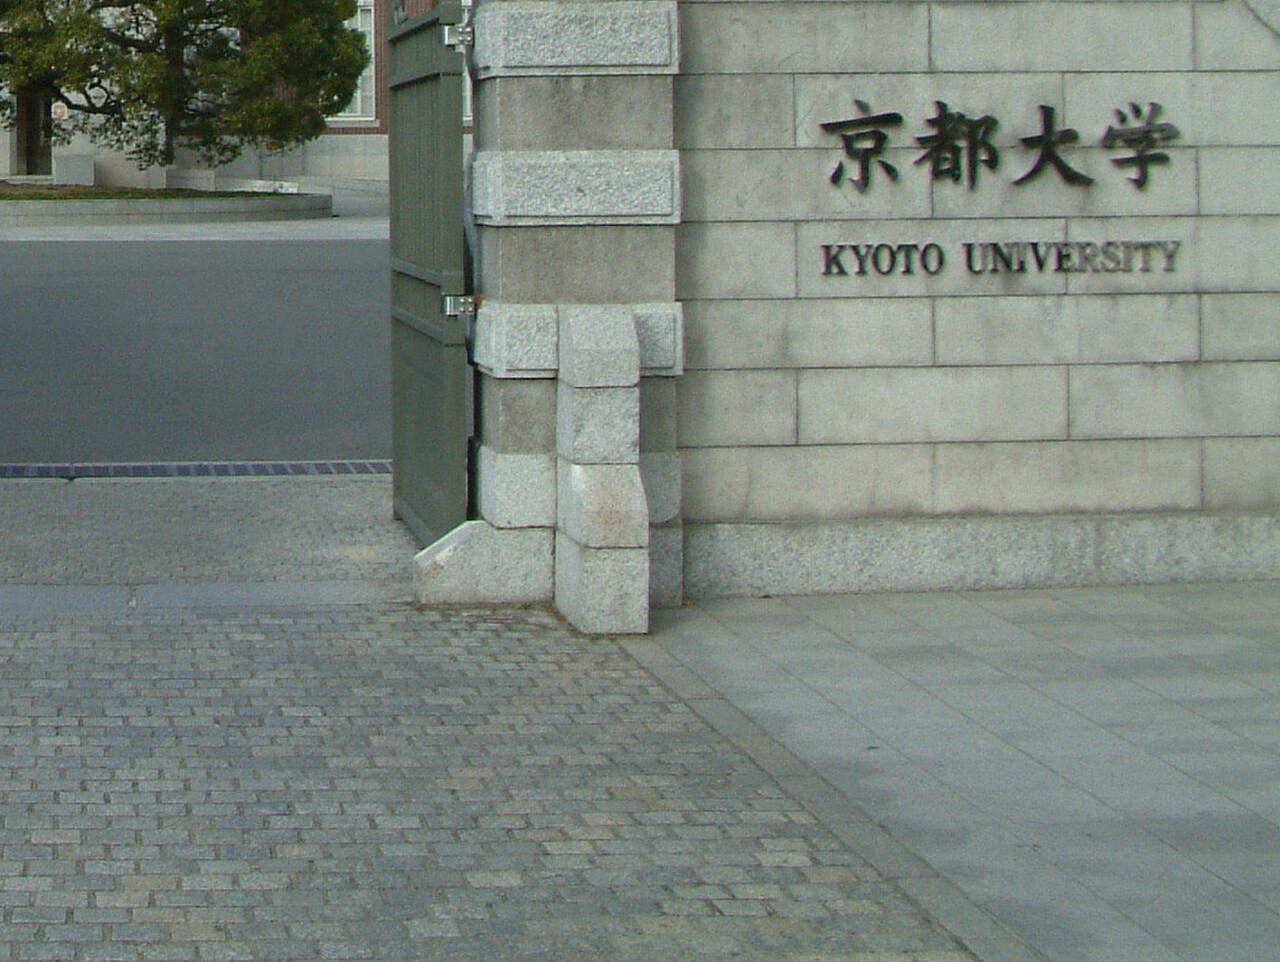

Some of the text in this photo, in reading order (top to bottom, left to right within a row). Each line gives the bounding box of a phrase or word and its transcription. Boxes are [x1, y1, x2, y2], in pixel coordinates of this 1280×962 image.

[819, 99, 1181, 191] 京都大学
[820, 241, 1182, 276] KYOTO UNIVERSITY
